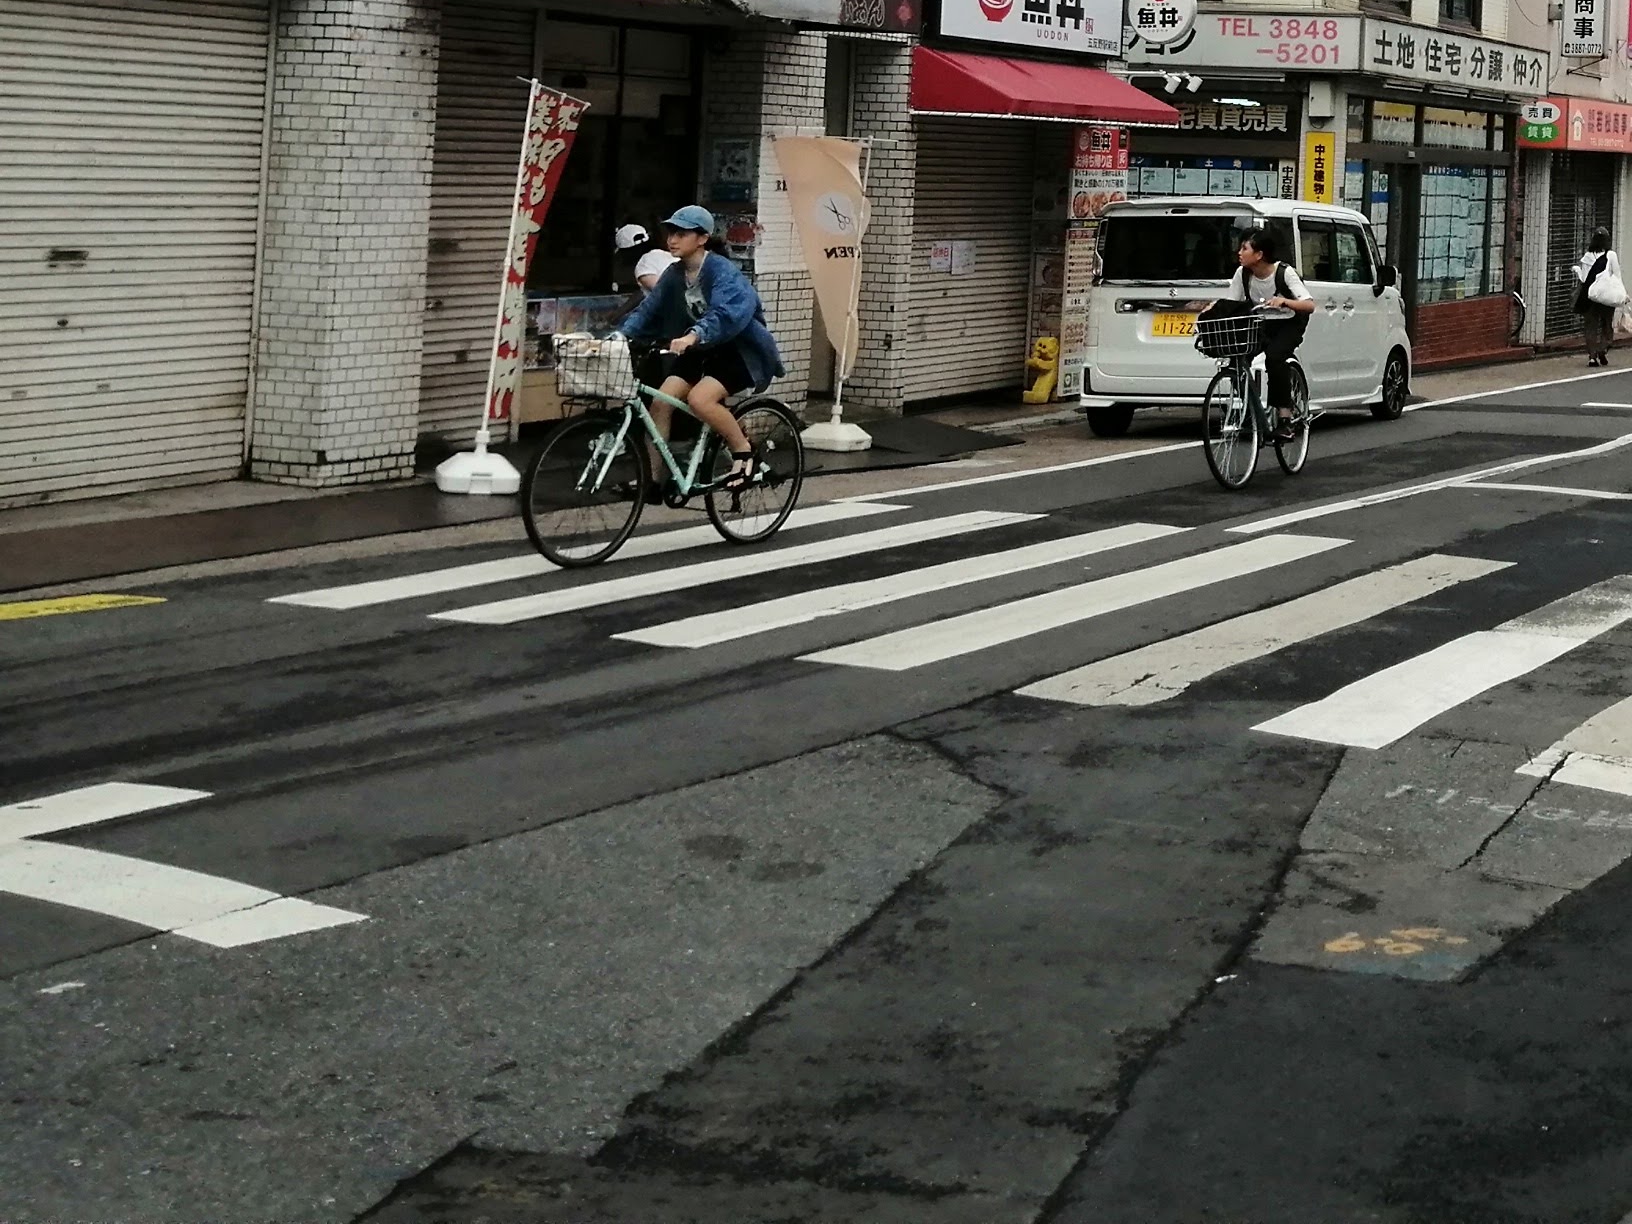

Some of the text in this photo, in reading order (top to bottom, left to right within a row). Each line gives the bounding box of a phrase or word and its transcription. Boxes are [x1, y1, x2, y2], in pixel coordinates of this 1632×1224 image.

[1137, 7, 1179, 29] 魚丼
[1217, 17, 1339, 40] TEL 3848
[1037, 29, 1070, 42] UODON
[1255, 43, 1341, 65] -5201
[1571, 42, 1602, 54] 3887-0772
[1528, 107, 1553, 119] 売買
[1163, 322, 1193, 334] 11-22
